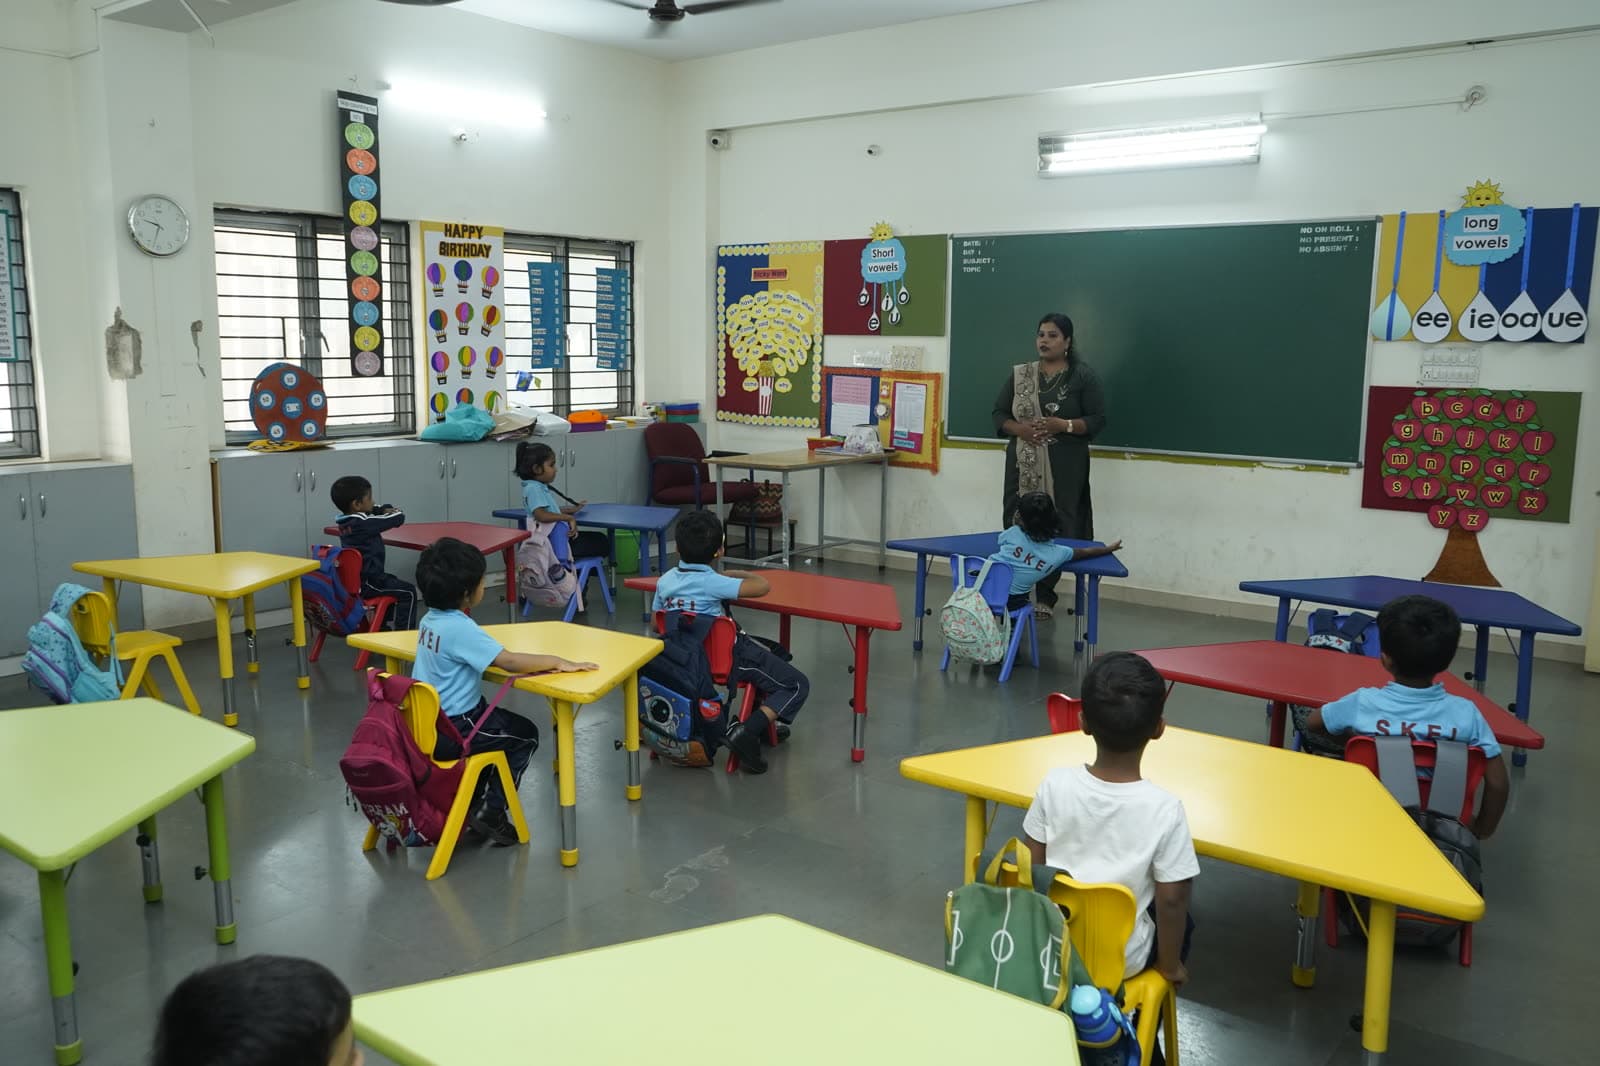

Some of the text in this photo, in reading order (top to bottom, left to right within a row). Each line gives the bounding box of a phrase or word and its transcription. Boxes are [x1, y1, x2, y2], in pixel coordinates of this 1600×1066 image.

[444, 224, 484, 239] HAPPY
[1464, 216, 1499, 231] long
[438, 241, 492, 258] BIRTHDAY
[1455, 237, 1508, 249] vowels
[872, 248, 894, 258] Short
[868, 263, 898, 272] vowels
[884, 295, 889, 310] i
[899, 291, 908, 304] o
[869, 318, 879, 329] e
[890, 312, 899, 324] u
[1416, 311, 1450, 328] ee
[1469, 308, 1495, 329] ie
[1501, 312, 1538, 328] oa
[1548, 311, 1584, 328] ue
[1421, 401, 1524, 418] b c d f
[1402, 422, 1541, 450] g h j k l
[1392, 452, 1539, 480] m n p q r
[1392, 481, 1537, 509] s t v w x
[1438, 510, 1479, 525] y z
[1013, 546, 1054, 573] SKEI
[1376, 719, 1458, 741] SKEI
